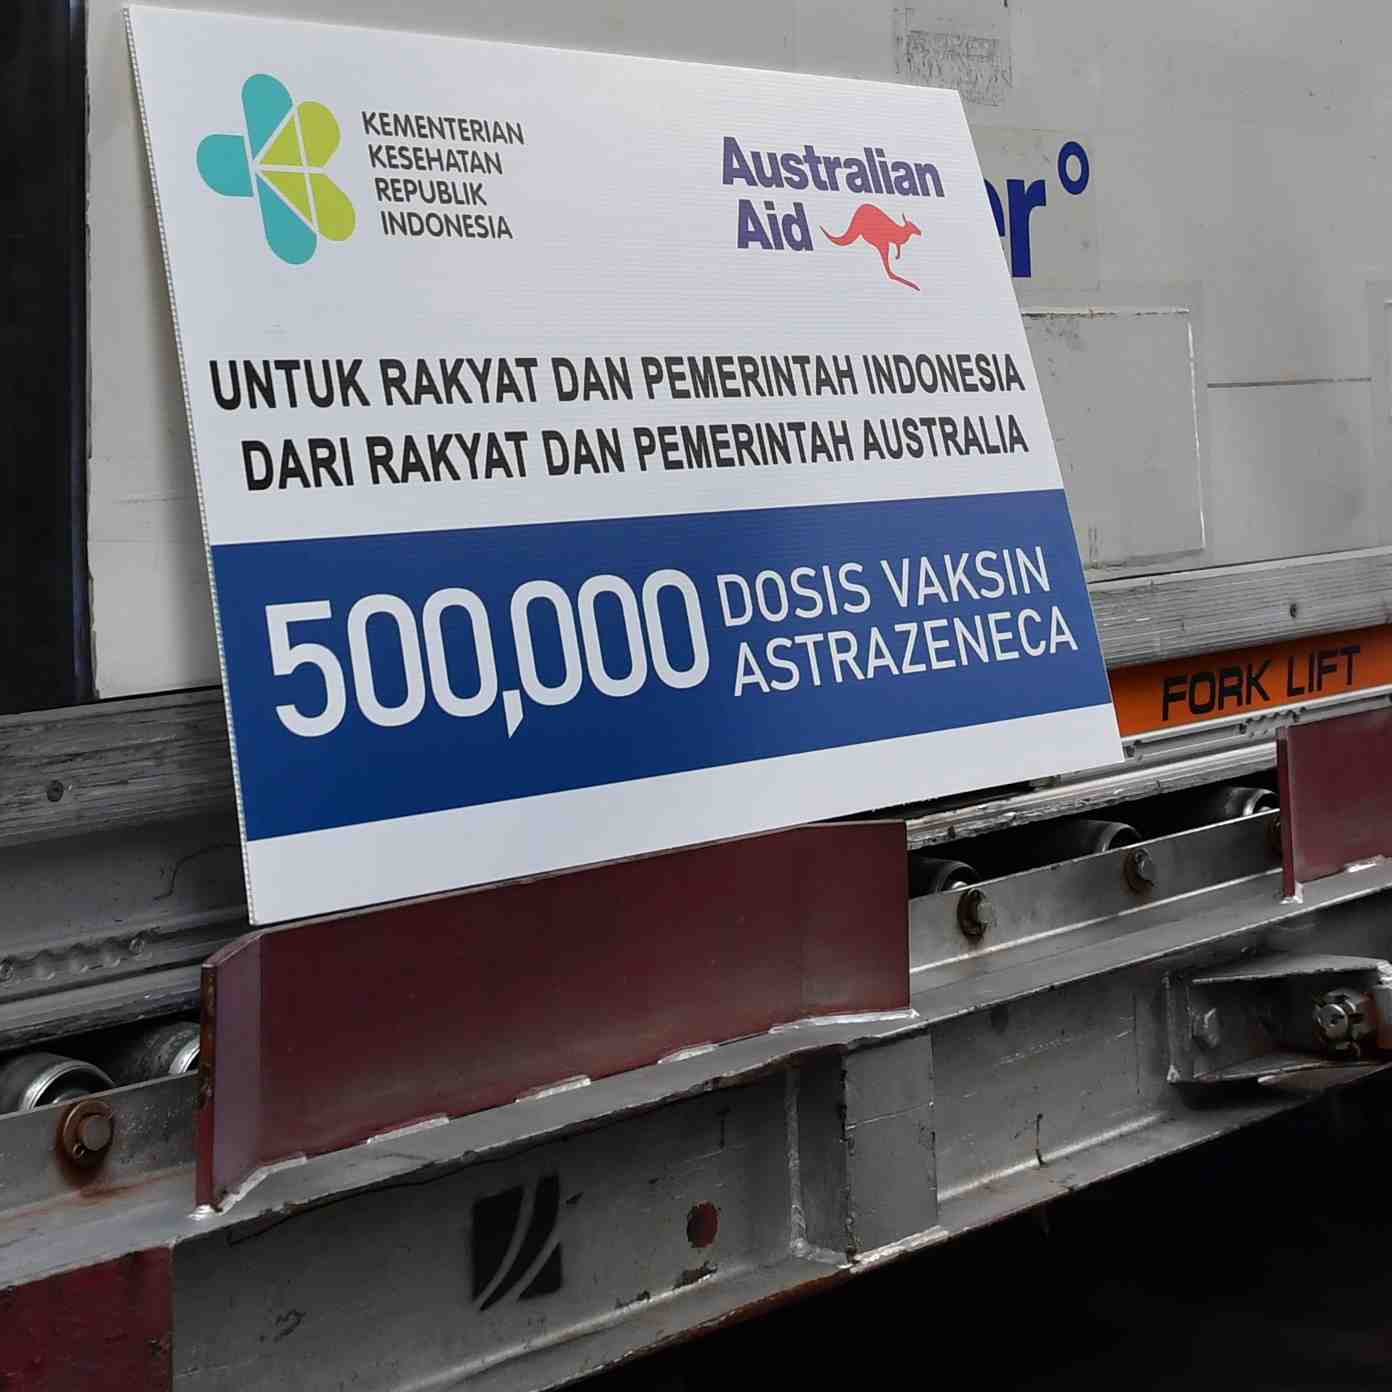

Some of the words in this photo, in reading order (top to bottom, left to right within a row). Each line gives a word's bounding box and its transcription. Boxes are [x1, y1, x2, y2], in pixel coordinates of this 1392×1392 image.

[361, 110, 525, 145] KEMENTERIAN
[368, 143, 504, 175] KESEHATAN
[722, 136, 946, 198] Australian
[374, 177, 488, 206] REPUBLIK
[380, 210, 514, 240] INDONESIA
[737, 198, 815, 252] Aid
[209, 358, 371, 411] UNTUK
[378, 356, 538, 406] RAKYAT
[550, 356, 634, 402] DAN
[640, 353, 859, 400] PEMERINTAH
[861, 353, 1026, 395] INDONESIA
[240, 436, 355, 492] DARI
[365, 430, 528, 485] RAKYAT
[541, 427, 626, 476] DAN
[633, 419, 855, 472] PEMERINTAH
[862, 413, 1030, 461] AUSTRALIA
[716, 561, 872, 627] DOSIS
[879, 545, 1051, 608] VAKSIN
[264, 568, 710, 740] 500,000
[734, 605, 1079, 698] ASTRAZENECA
[1161, 658, 1273, 721] FORK
[1286, 644, 1361, 698] LIFT
